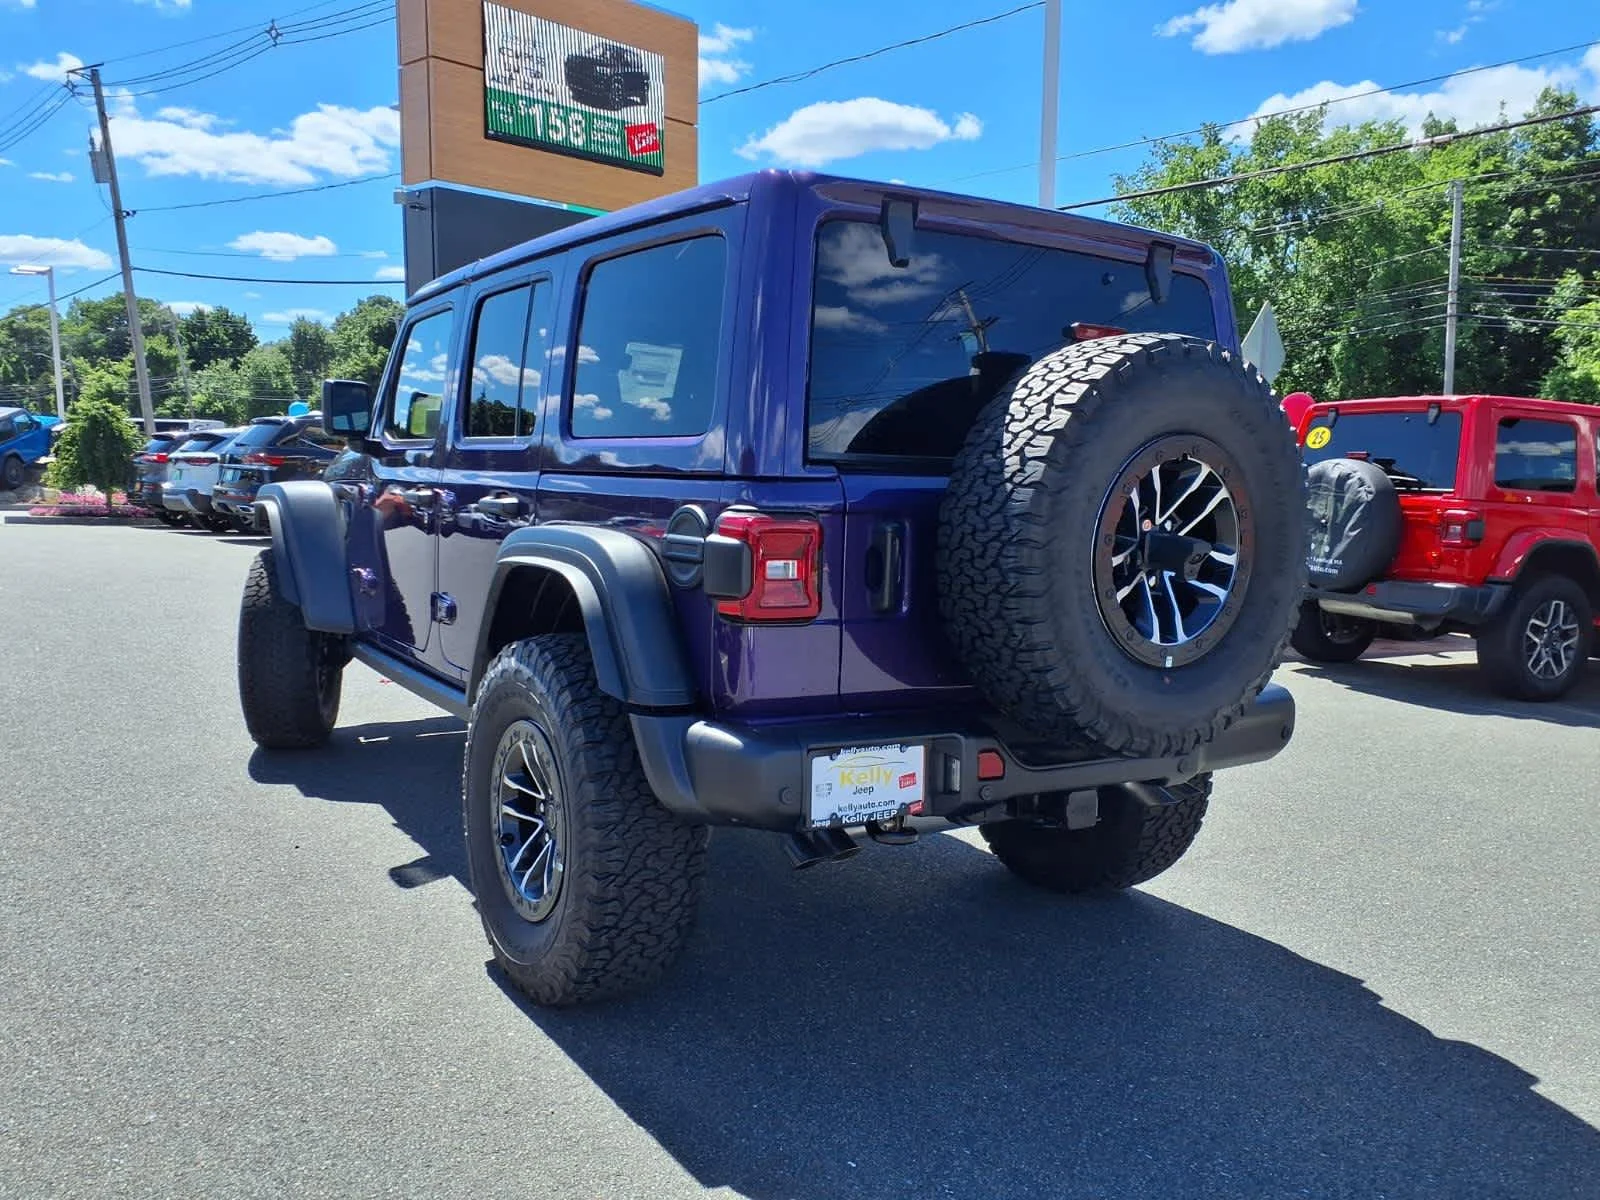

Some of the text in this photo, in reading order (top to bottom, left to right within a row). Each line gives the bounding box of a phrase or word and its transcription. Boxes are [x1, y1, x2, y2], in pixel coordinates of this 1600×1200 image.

[517, 98, 586, 148] $158
[840, 744, 901, 755] kellyauto.com
[840, 768, 893, 787] Kelly
[852, 785, 874, 796] Jeep
[839, 799, 895, 813] kellyauto.com
[812, 819, 831, 828] Jeep
[842, 810, 898, 824] Kelly JEEP
